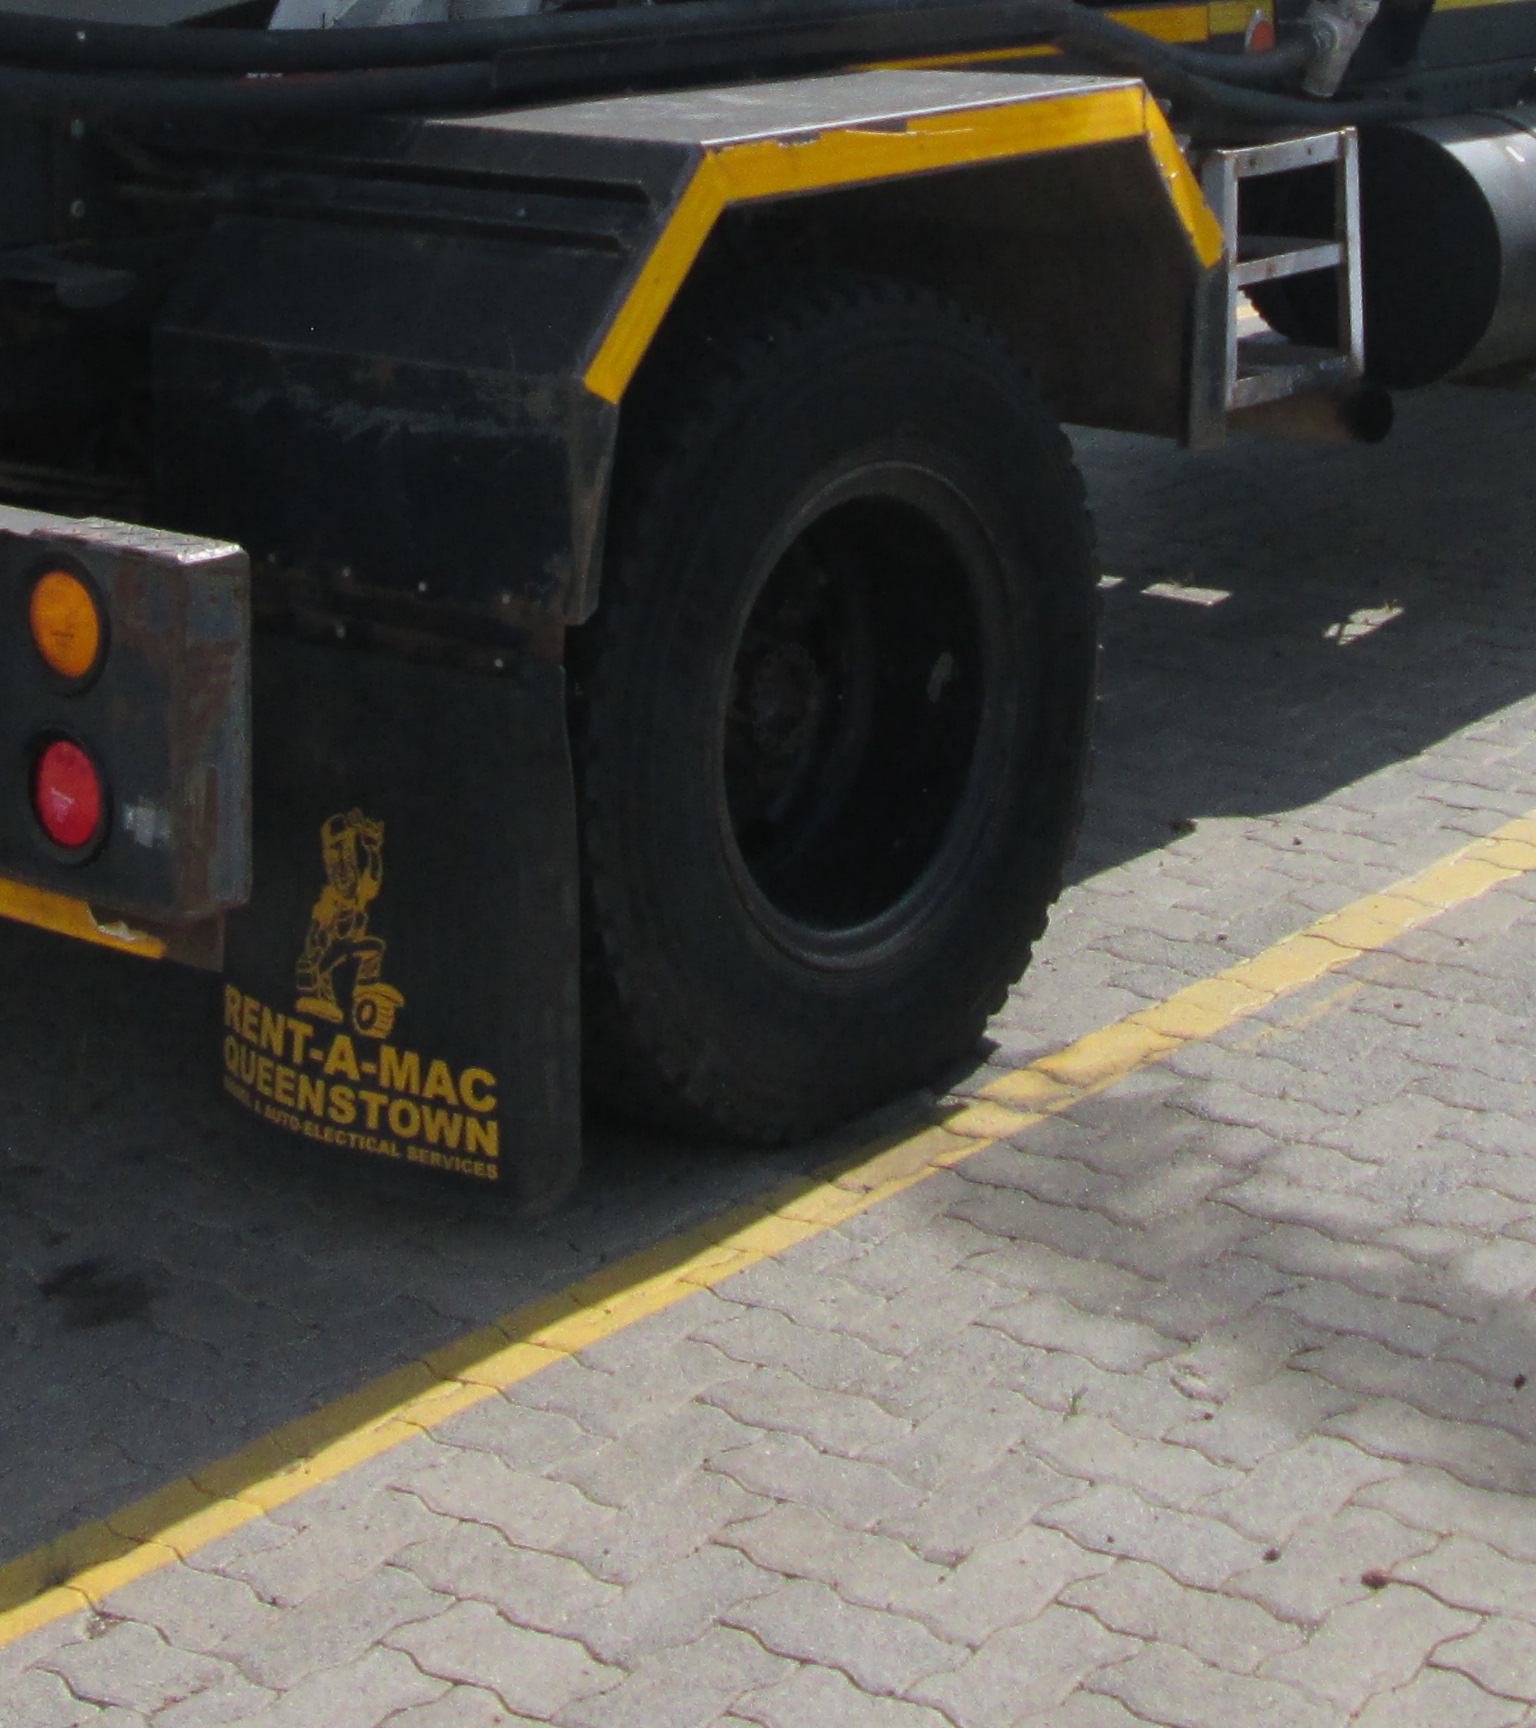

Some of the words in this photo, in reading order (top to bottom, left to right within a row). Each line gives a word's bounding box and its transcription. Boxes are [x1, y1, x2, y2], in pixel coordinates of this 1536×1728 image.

[224, 983, 498, 1113] RENT-A-MAC
[224, 1035, 499, 1157] QUEENSTOWN
[407, 1144, 499, 1181] SERVICES
